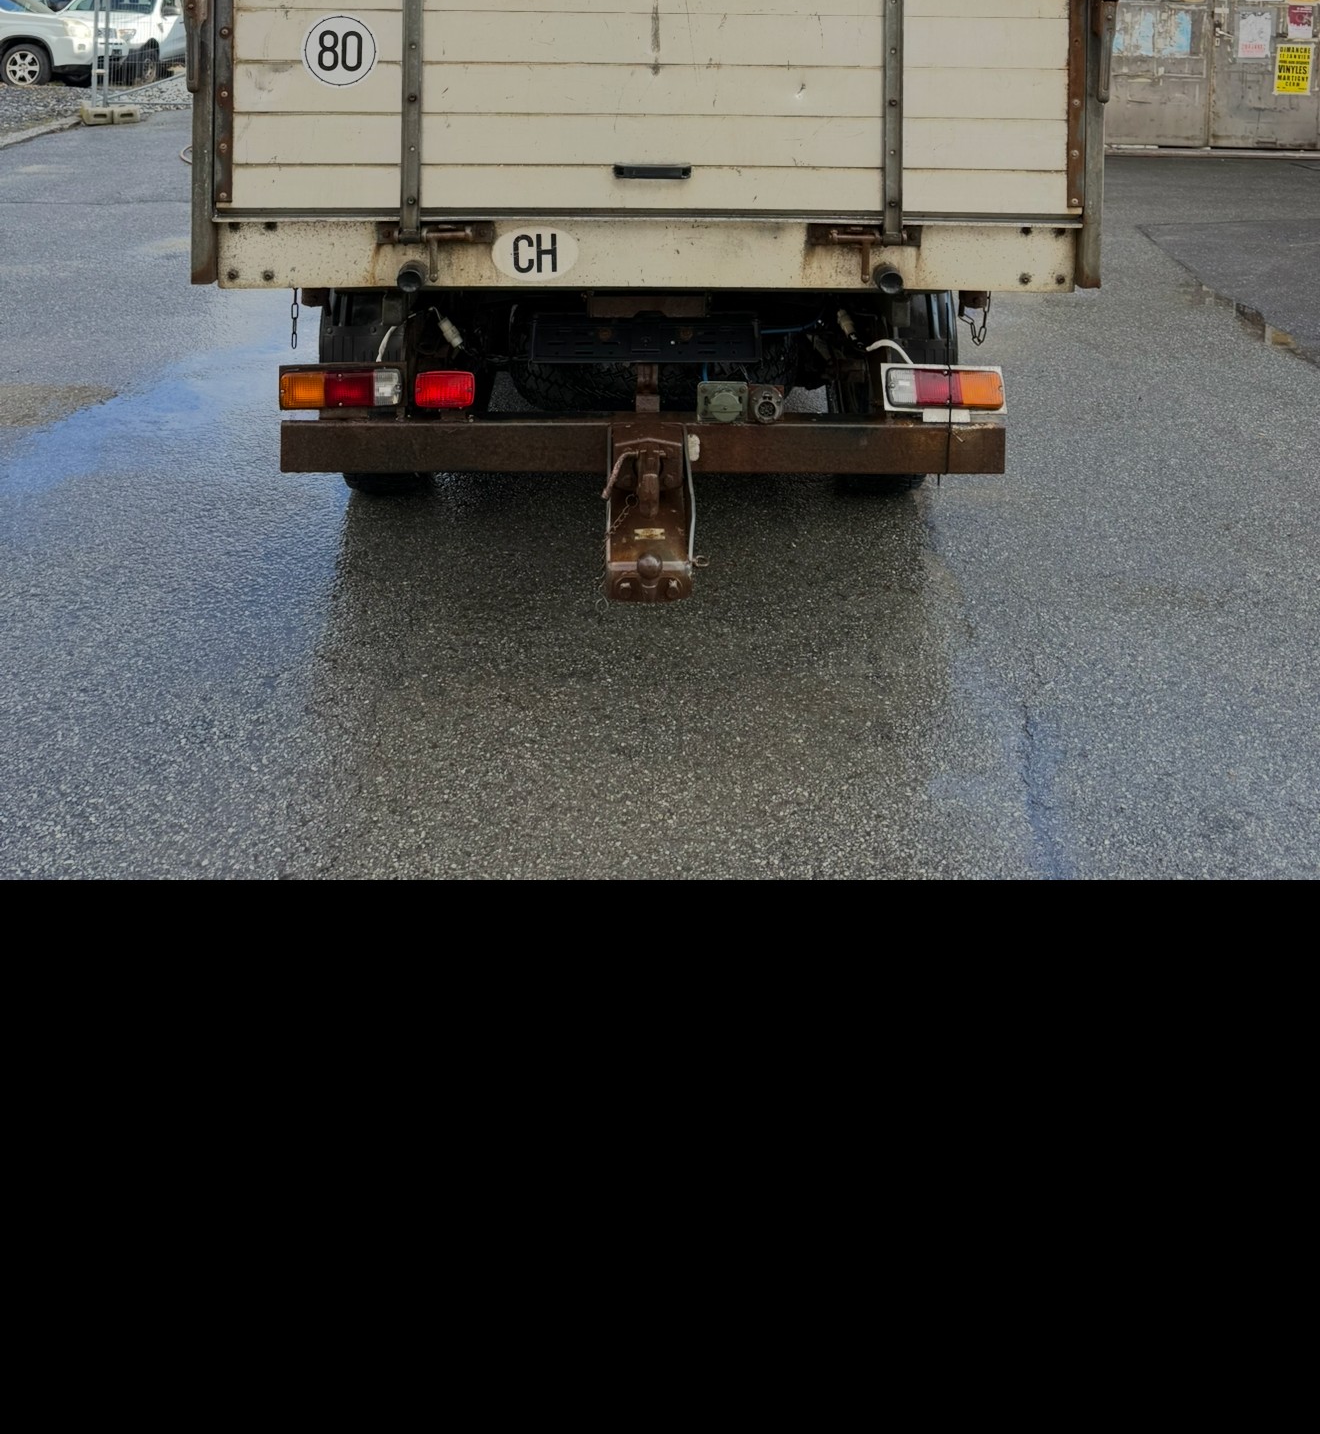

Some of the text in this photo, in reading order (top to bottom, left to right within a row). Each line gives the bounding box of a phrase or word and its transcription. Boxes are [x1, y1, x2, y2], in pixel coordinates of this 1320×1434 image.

[318, 30, 362, 72] 80
[1278, 65, 1307, 74] VINYLES
[513, 233, 557, 273] CH
